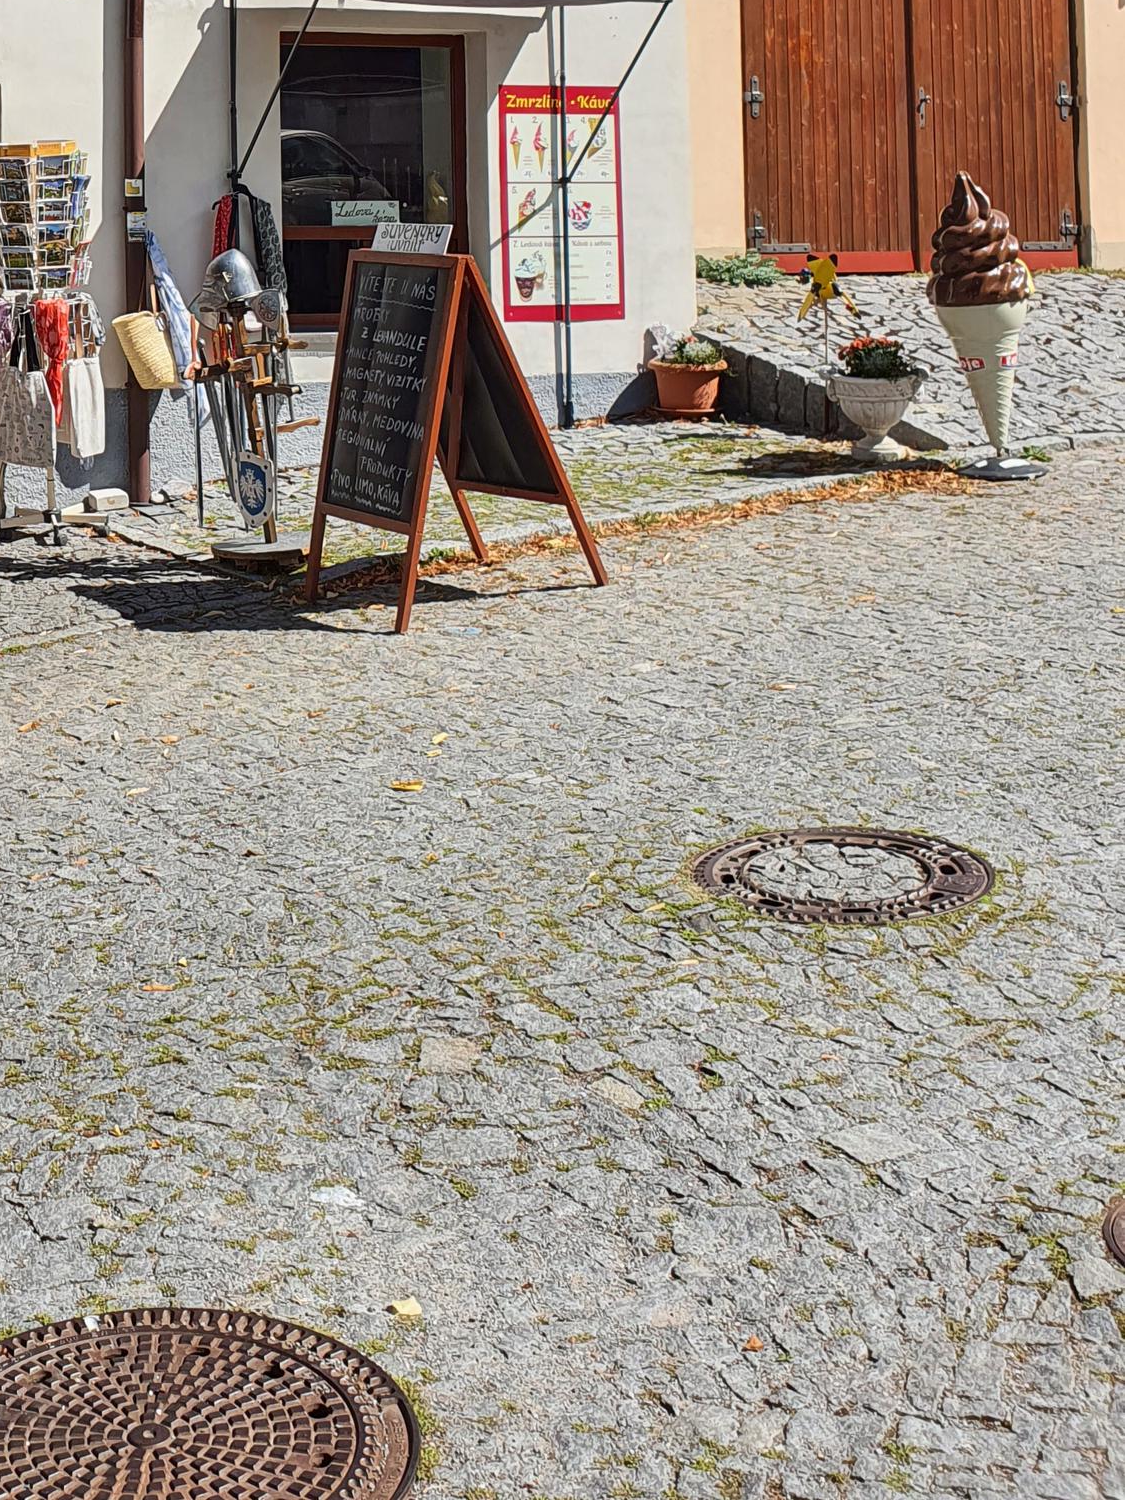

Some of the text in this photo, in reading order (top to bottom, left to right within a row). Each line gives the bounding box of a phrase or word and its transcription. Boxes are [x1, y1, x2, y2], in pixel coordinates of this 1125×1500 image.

[505, 94, 562, 108] Zmrzlin
[334, 202, 375, 218] Ledová
[411, 277, 436, 301] NÁS
[372, 414, 425, 442] MEDOVINA
[360, 456, 413, 486] PRODUKTY
